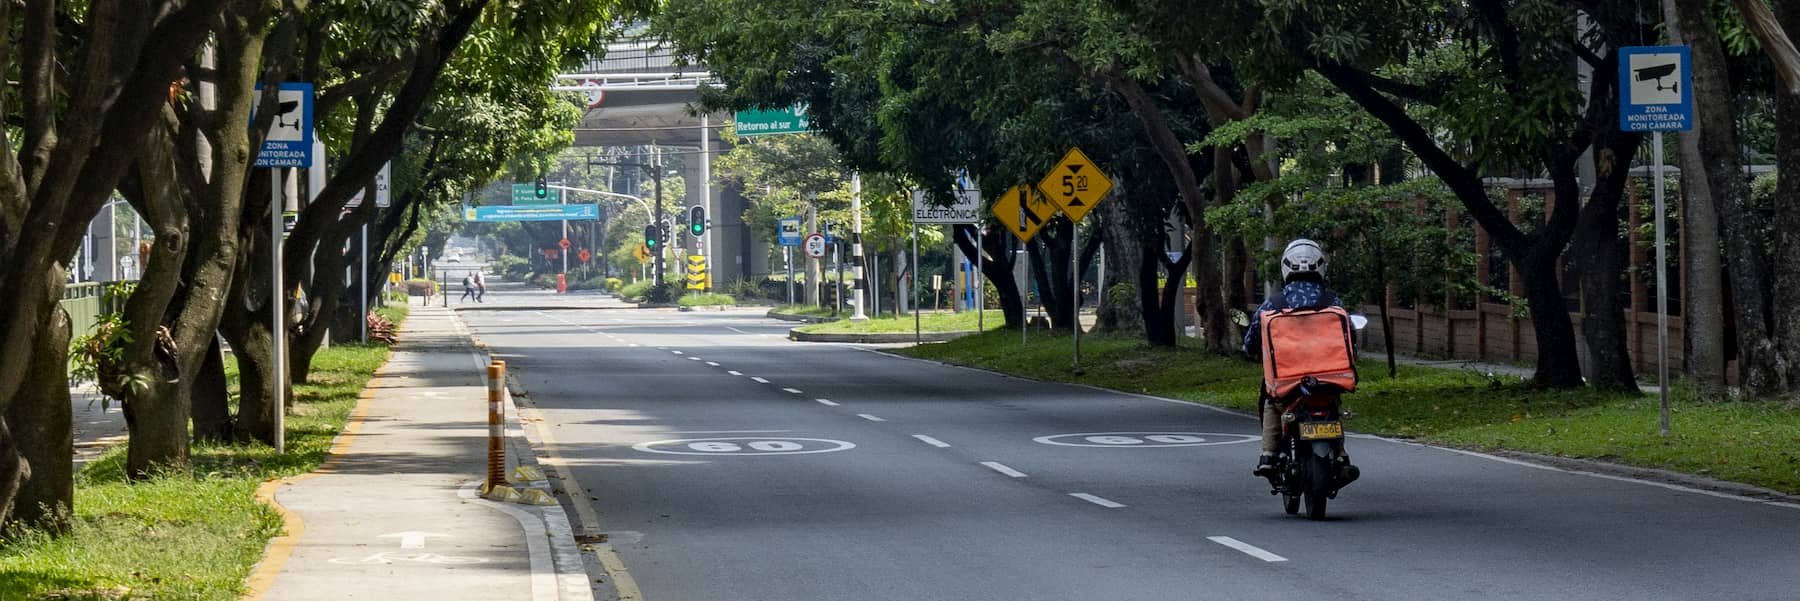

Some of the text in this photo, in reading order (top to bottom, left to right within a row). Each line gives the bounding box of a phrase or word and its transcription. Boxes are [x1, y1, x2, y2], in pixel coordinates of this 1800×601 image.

[1645, 105, 1668, 113] ZONA
[1627, 113, 1686, 121] MONITOREADA
[737, 120, 792, 131] Retorno al sur
[1631, 122, 1647, 130] CON
[266, 142, 289, 150] ZONA
[257, 150, 305, 158] NITOREADA
[254, 158, 269, 166] ON
[688, 441, 803, 452] 60
